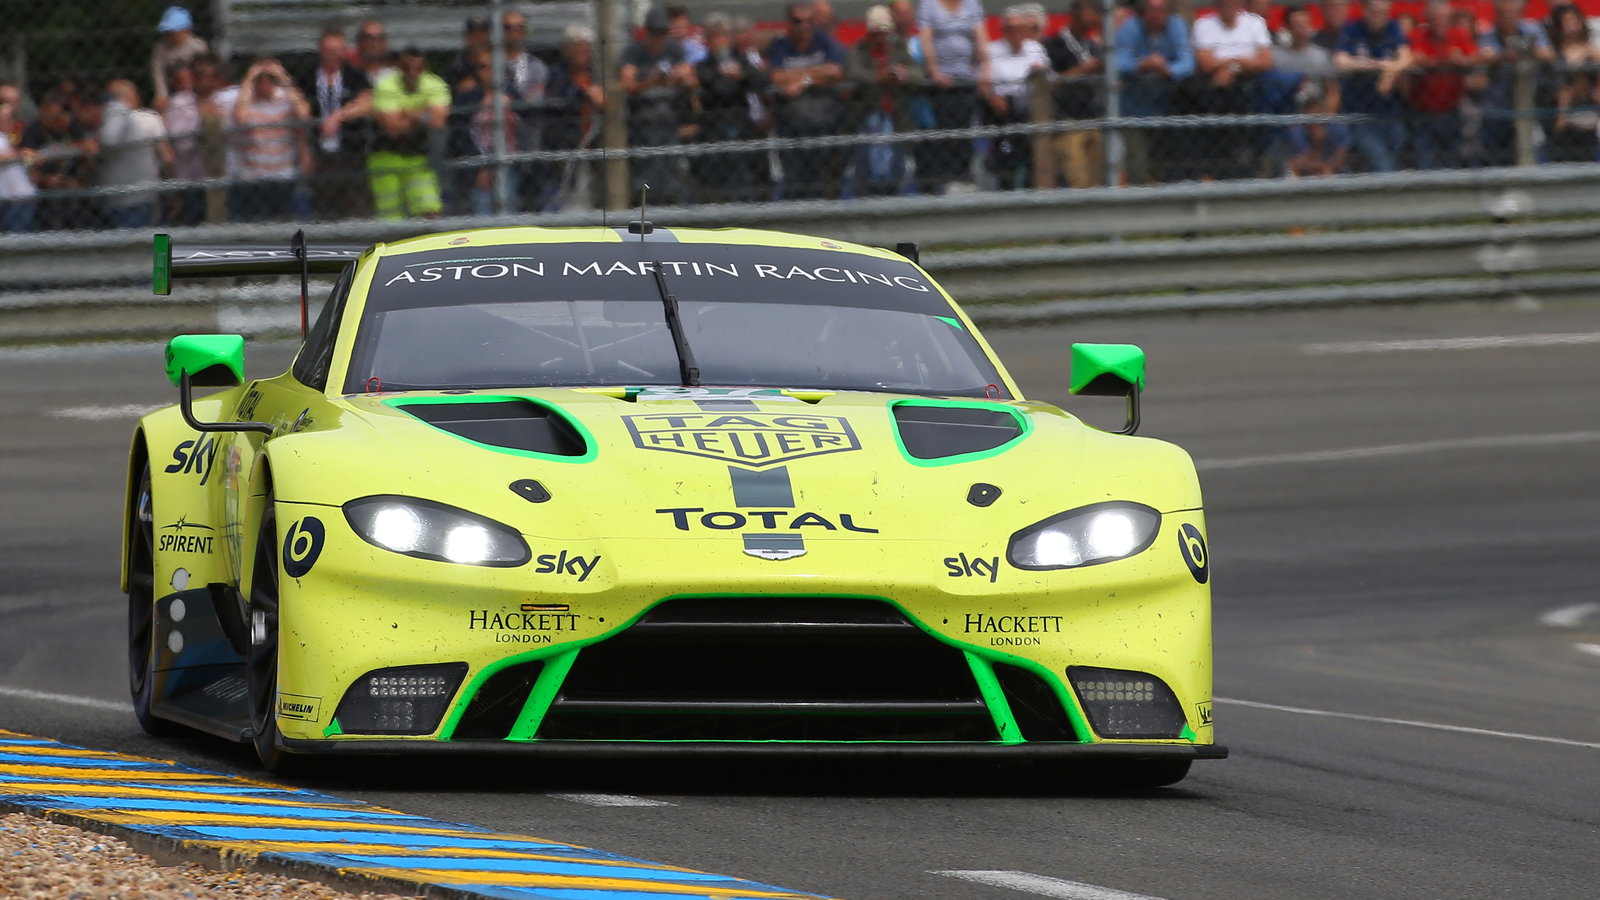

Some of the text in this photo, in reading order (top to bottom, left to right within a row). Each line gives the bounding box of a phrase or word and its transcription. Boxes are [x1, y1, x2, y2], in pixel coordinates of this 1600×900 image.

[385, 261, 930, 293] ASTON MARTIN RACING
[644, 415, 829, 430] TAG
[649, 432, 844, 460] HEUER
[164, 432, 222, 486] sky
[655, 507, 880, 534] TOTAL
[159, 534, 213, 553] SPIRENT
[535, 550, 602, 582] sky
[943, 552, 999, 583] sky
[469, 610, 580, 631] HACKETT
[964, 613, 1063, 633] HACKETT
[495, 632, 551, 643] LONDON
[990, 637, 1041, 646] LONDON
